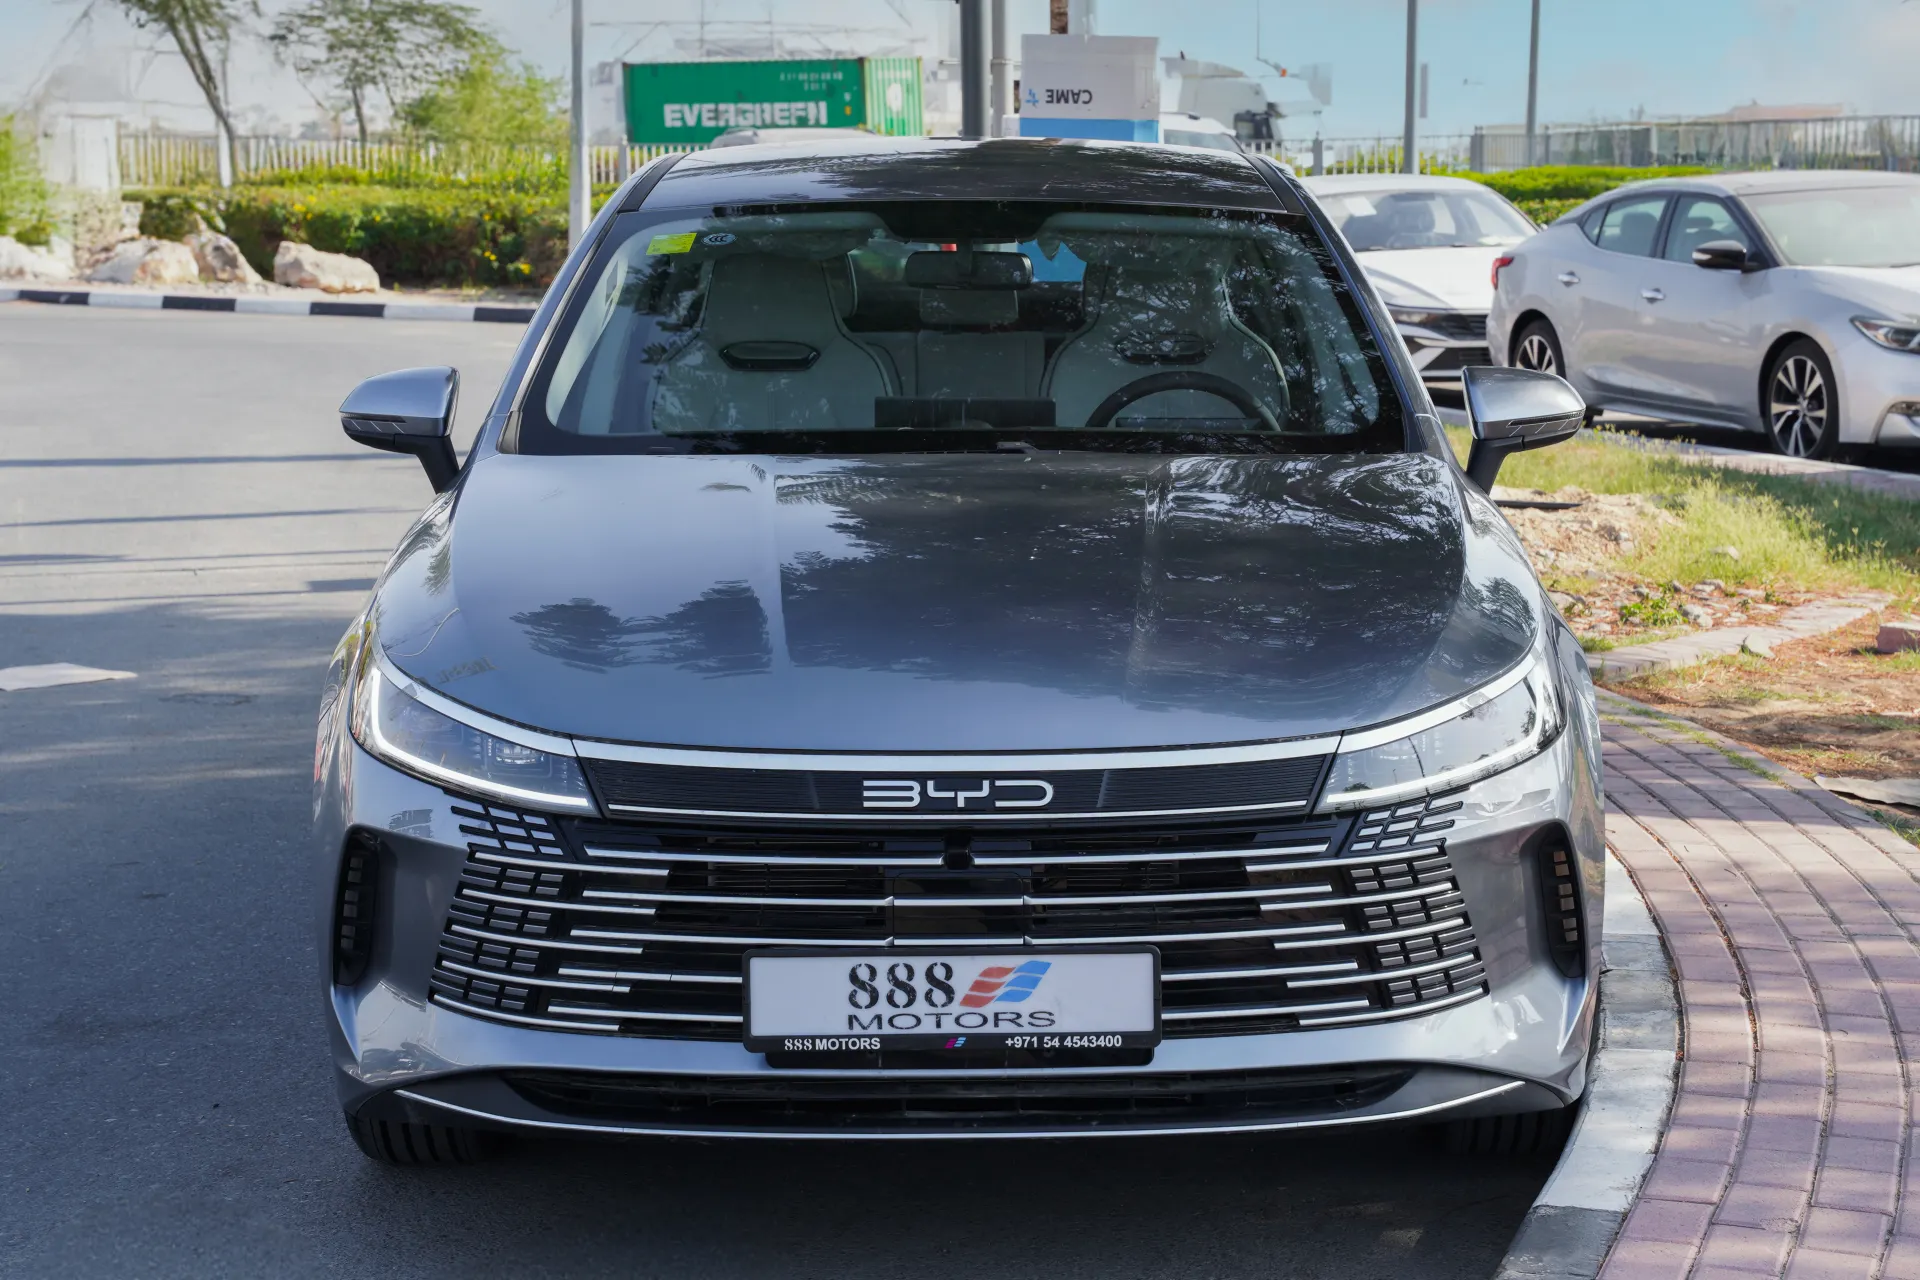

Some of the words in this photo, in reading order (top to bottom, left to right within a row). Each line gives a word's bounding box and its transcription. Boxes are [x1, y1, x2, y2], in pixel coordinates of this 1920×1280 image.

[1045, 89, 1093, 104] CAME
[863, 780, 1054, 807] BYD
[848, 962, 955, 1009] 888
[848, 1011, 1056, 1030] MOTORS
[784, 1038, 812, 1050] 888
[815, 1037, 881, 1050] MOTORS
[1005, 1036, 1038, 1048] +971
[1043, 1036, 1060, 1048] 54
[1063, 1035, 1122, 1048] 4543400
